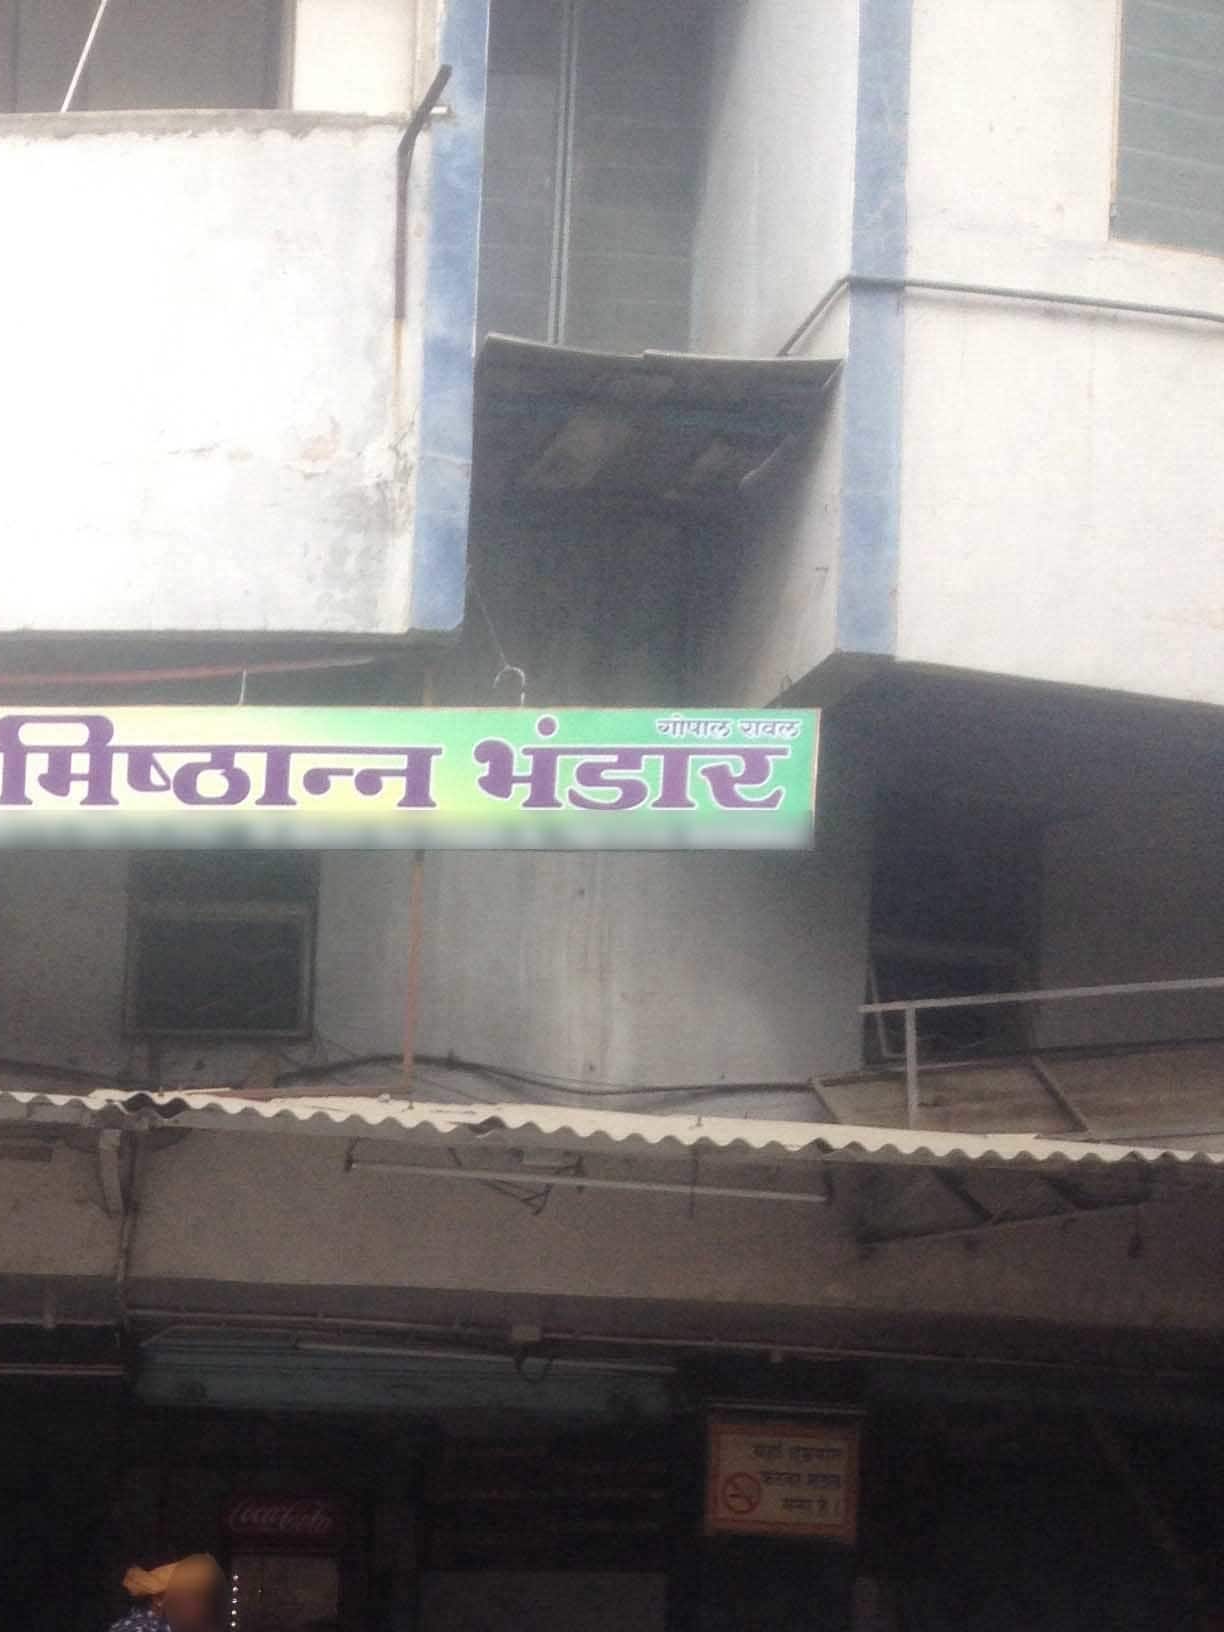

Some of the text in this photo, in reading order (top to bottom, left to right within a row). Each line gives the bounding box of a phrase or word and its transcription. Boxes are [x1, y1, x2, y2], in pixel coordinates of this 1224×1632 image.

[656, 714, 801, 738] गोपाल रावल
[474, 716, 790, 810] भंडार
